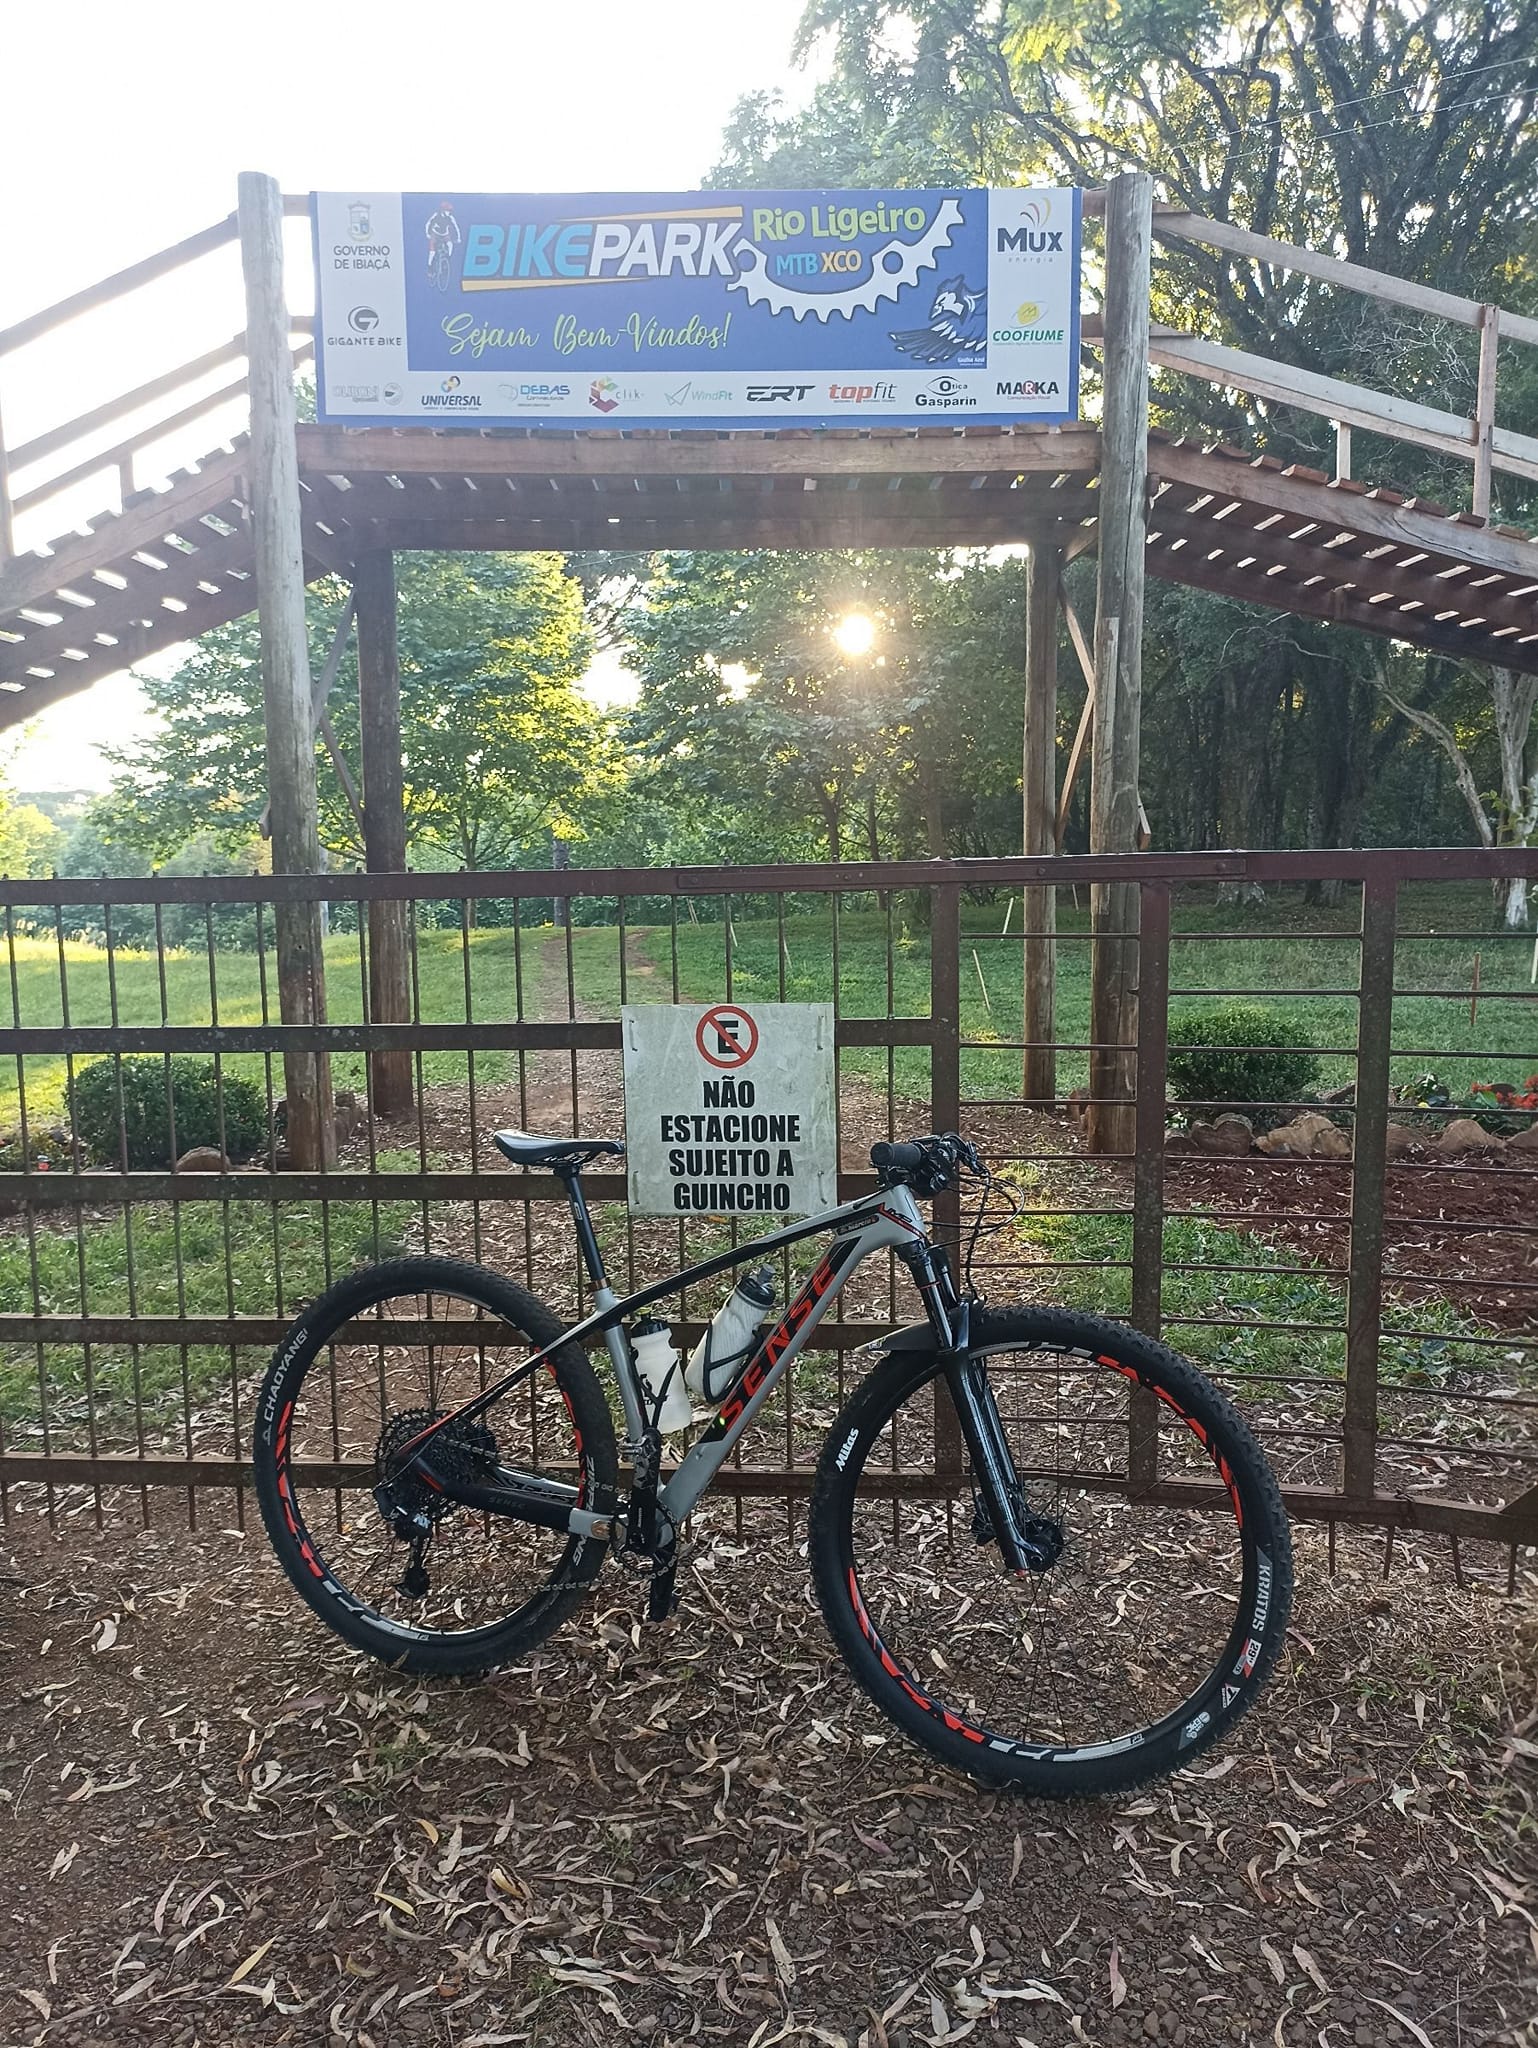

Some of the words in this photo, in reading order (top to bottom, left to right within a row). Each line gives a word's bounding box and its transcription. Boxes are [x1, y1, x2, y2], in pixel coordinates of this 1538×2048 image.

[752, 206, 806, 242] Rio
[811, 200, 926, 242] Ligeiro
[333, 245, 391, 256] GOVERNO
[461, 222, 743, 278] BIKEPARK
[776, 252, 818, 276] MTB
[820, 249, 862, 274] XCO
[334, 258, 350, 270] DE
[327, 337, 375, 346] GIGANTE
[377, 337, 402, 346] BIKE
[441, 311, 539, 359] Sejam
[552, 311, 732, 357] Bem-Vindos!
[992, 329, 1065, 342] COOFIUME
[421, 395, 482, 406] UNIVERSAL
[520, 384, 571, 396] DEBAS
[829, 382, 897, 403] topfit
[915, 394, 977, 408] Gasparin
[996, 380, 1059, 396] MARKA
[717, 1020, 739, 1054] E
[703, 1075, 756, 1108] NÃO
[661, 1115, 800, 1142] ESTACIONE
[669, 1149, 770, 1177] SUJEITO
[776, 1149, 794, 1176] A
[673, 1183, 791, 1210] GUINCHO
[719, 1254, 837, 1432] SENSE
[264, 1330, 307, 1422] CHAOYANG
[835, 1427, 860, 1472] Mitas
[1252, 1564, 1271, 1632] KRATOS
